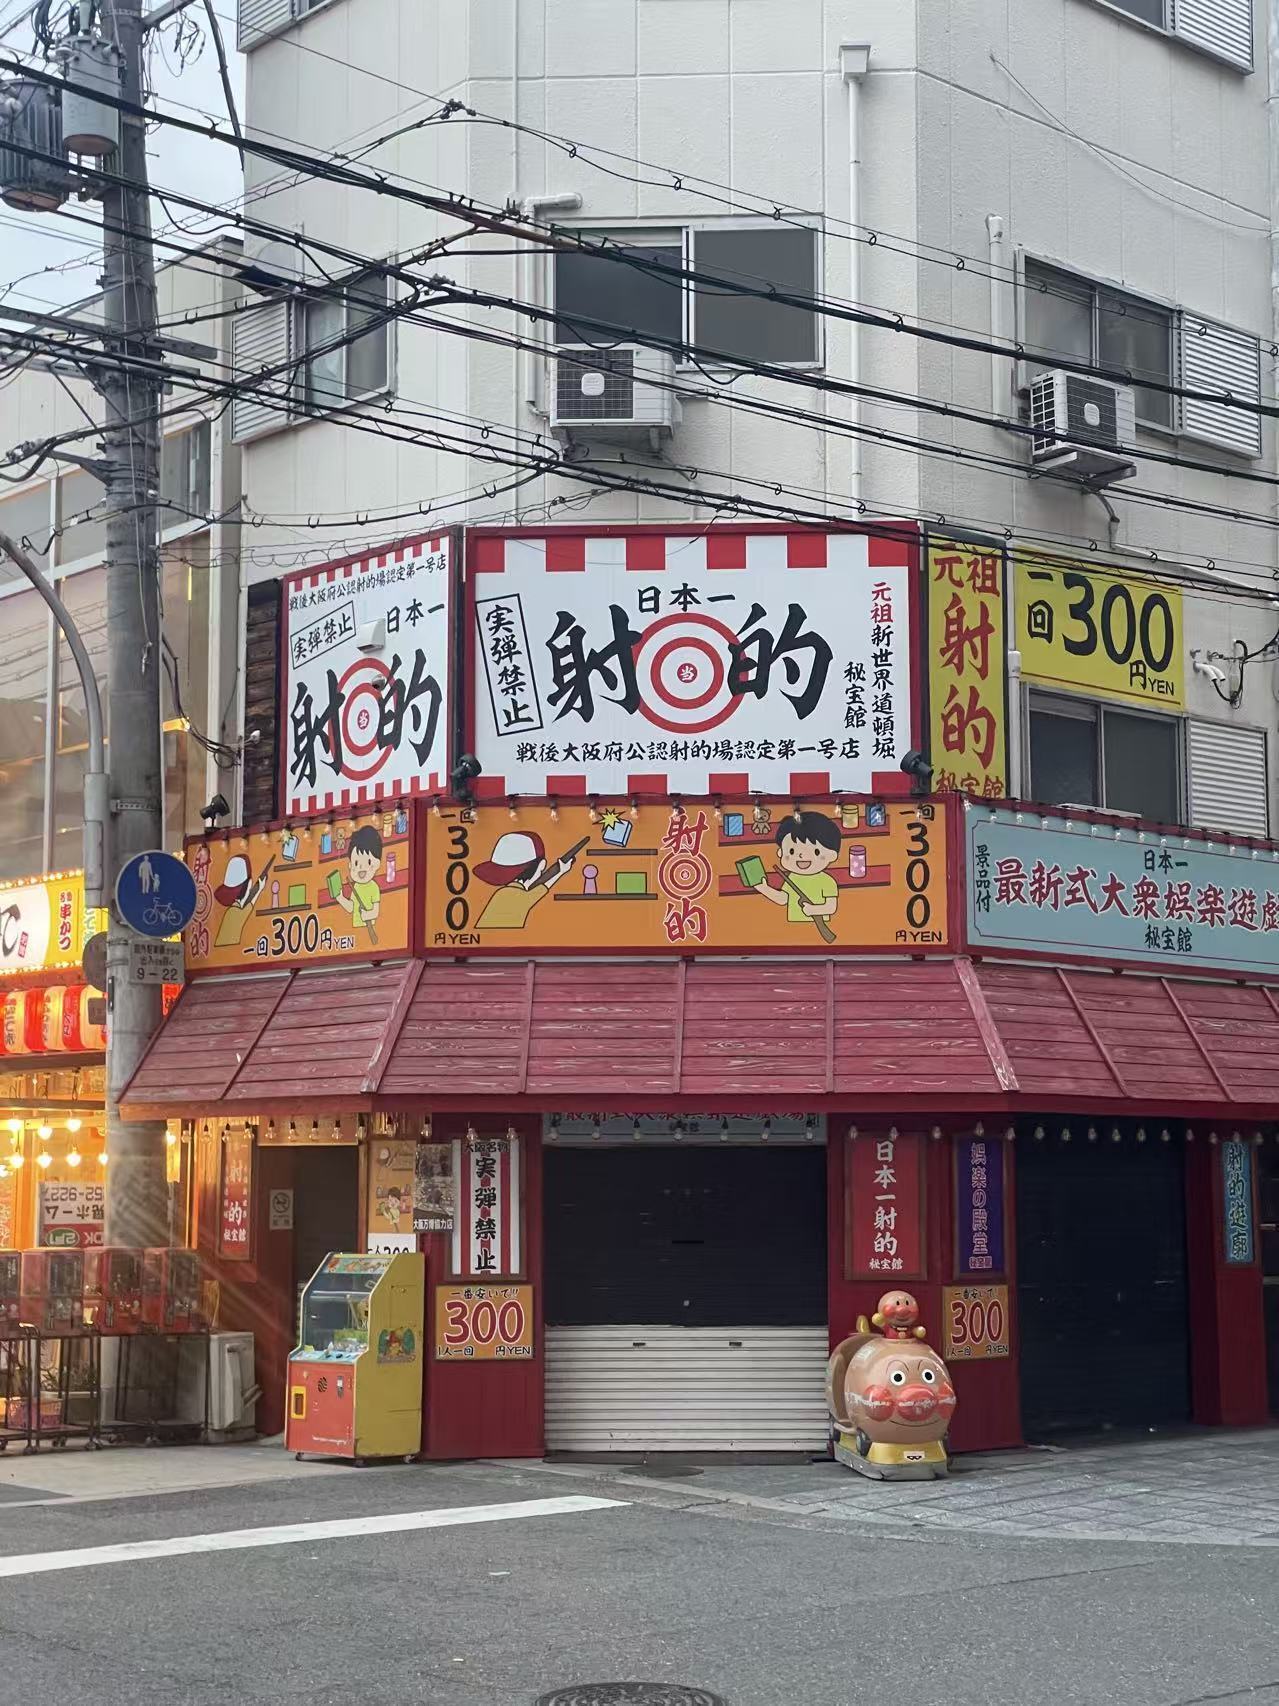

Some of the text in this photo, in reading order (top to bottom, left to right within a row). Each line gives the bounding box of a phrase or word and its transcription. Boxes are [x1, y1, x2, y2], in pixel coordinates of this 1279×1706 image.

[637, 582, 735, 614] 日本一
[934, 547, 1000, 598] 元祖
[293, 612, 354, 664] 実弾禁止
[385, 598, 446, 635] 日本一
[1061, 573, 1174, 672] 300
[485, 604, 534, 728] 実弾禁止
[545, 602, 834, 724] 射的
[843, 660, 867, 730] 秘宝館
[940, 592, 997, 770] 射的
[290, 648, 443, 791] 射的
[516, 738, 860, 763] 戦後大阪府公認射的場認定第一号店
[899, 803, 935, 821] 一回
[445, 825, 470, 931] 300
[660, 801, 709, 943] 射的
[906, 821, 931, 929] 300
[975, 844, 991, 913] 景品付
[1143, 849, 1189, 874] 日本一
[1144, 925, 1193, 953] 秘宝館
[474, 1156, 497, 1271] 実弾禁止
[872, 1140, 898, 1257] 日本一射的
[868, 1257, 903, 1271] 秘宝館
[444, 1300, 525, 1345] 300
[951, 1299, 1004, 1345] 300
